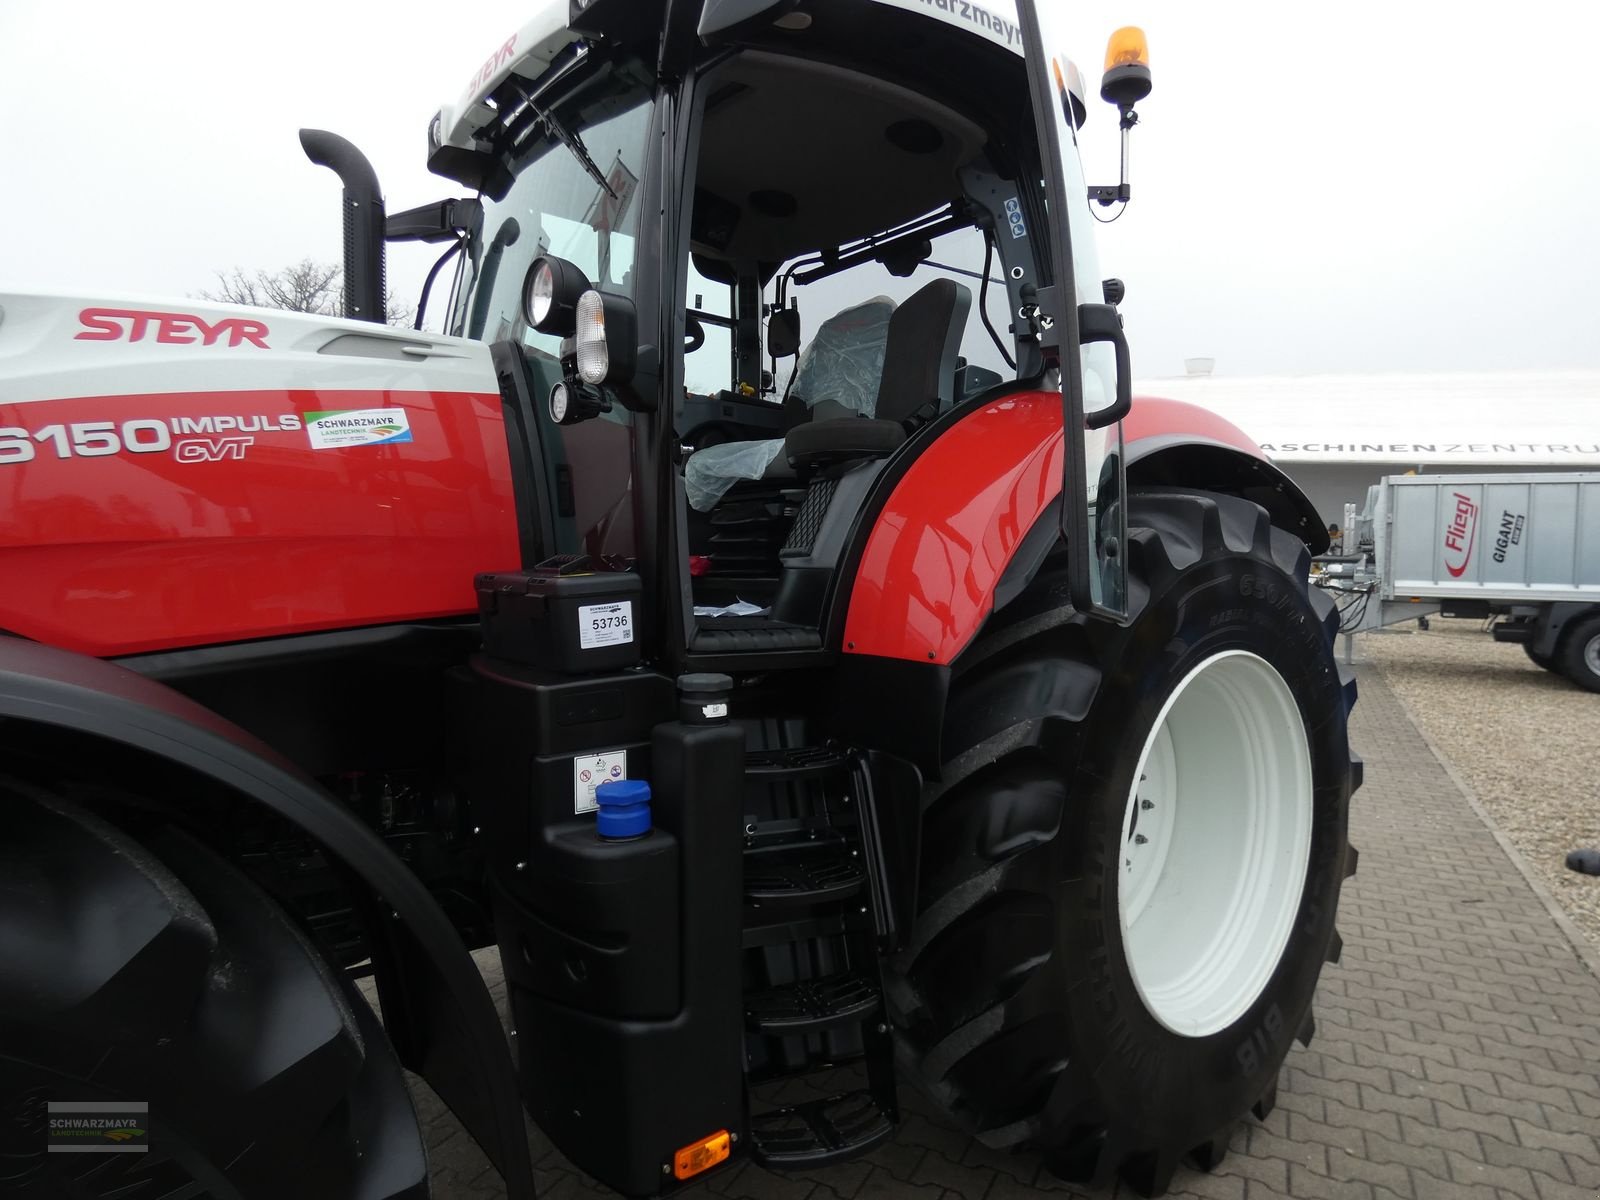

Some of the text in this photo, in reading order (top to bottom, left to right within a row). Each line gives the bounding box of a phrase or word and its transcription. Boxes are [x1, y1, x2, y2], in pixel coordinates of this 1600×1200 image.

[74, 308, 271, 349] STEYR
[171, 415, 301, 434] IMPULS
[316, 417, 395, 429] SCHWARZMAYR
[321, 428, 368, 436] LANDTECHNIK
[176, 436, 254, 463] CVT
[1445, 492, 1474, 552] Fliegl
[1492, 510, 1515, 563] GIGANT
[592, 615, 628, 630] 53736
